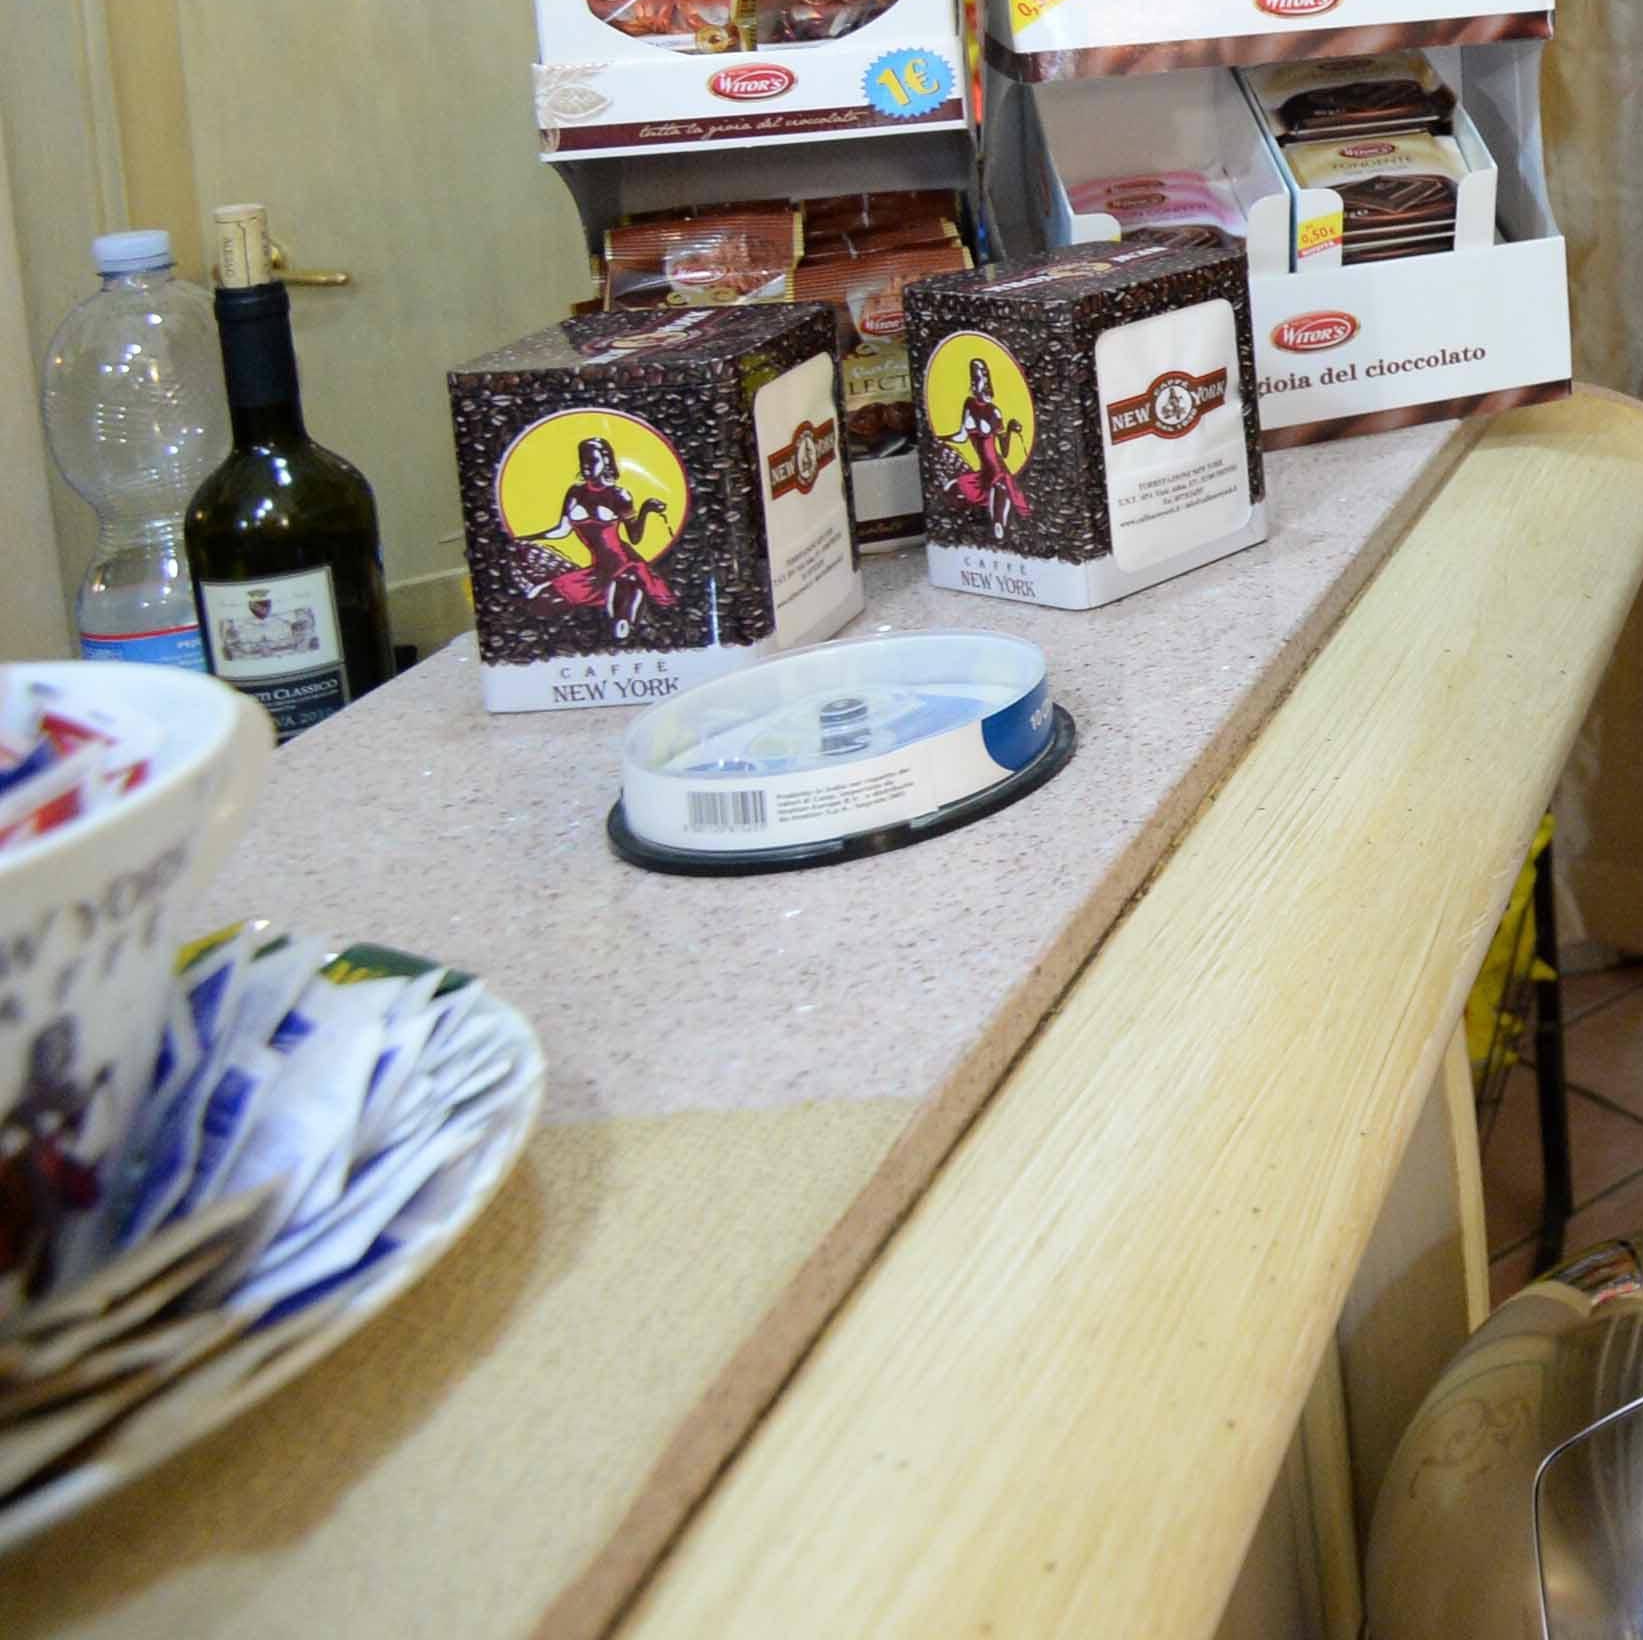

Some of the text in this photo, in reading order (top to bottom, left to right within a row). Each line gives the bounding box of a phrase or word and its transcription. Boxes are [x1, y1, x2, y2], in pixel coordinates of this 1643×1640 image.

[717, 72, 786, 94] WITOR'S
[876, 58, 941, 106] 1€
[1280, 321, 1348, 346] WITOR'S
[1324, 364, 1357, 386] del
[1363, 346, 1486, 379] cioccolato
[1111, 380, 1226, 433] NEW YORK
[768, 461, 796, 487] NEW
[960, 570, 1037, 599] NEW YORK
[273, 679, 339, 701] CLASSICO
[552, 675, 680, 705] NEW YORK
